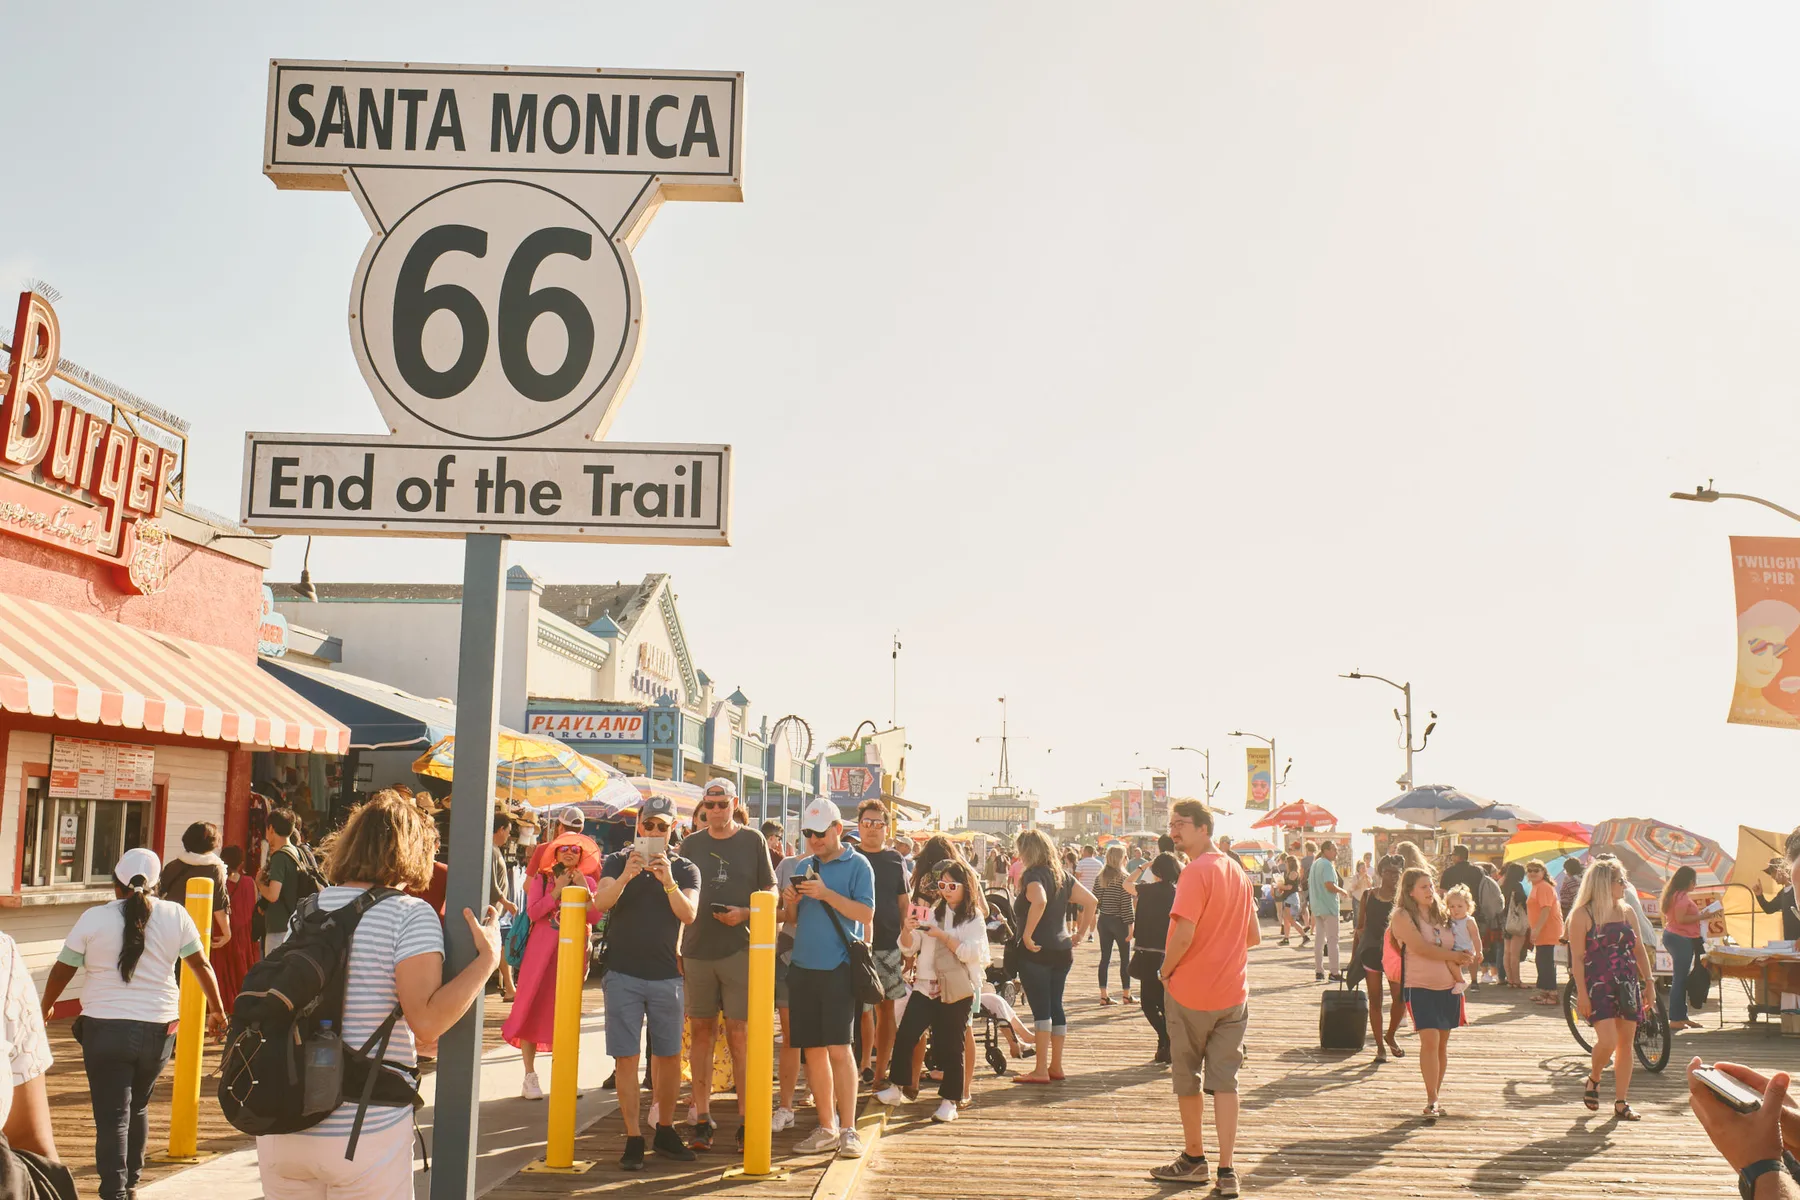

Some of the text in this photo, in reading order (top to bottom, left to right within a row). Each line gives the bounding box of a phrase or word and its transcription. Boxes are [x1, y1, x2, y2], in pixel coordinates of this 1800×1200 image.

[287, 84, 720, 160] SANTA MONICA
[392, 224, 595, 402] 66
[4, 291, 179, 556] Burger
[269, 452, 703, 519] End of the Trail
[1763, 571, 1795, 585] PIER
[531, 715, 642, 731] PLAYLAND
[548, 731, 625, 739] ARCADE
